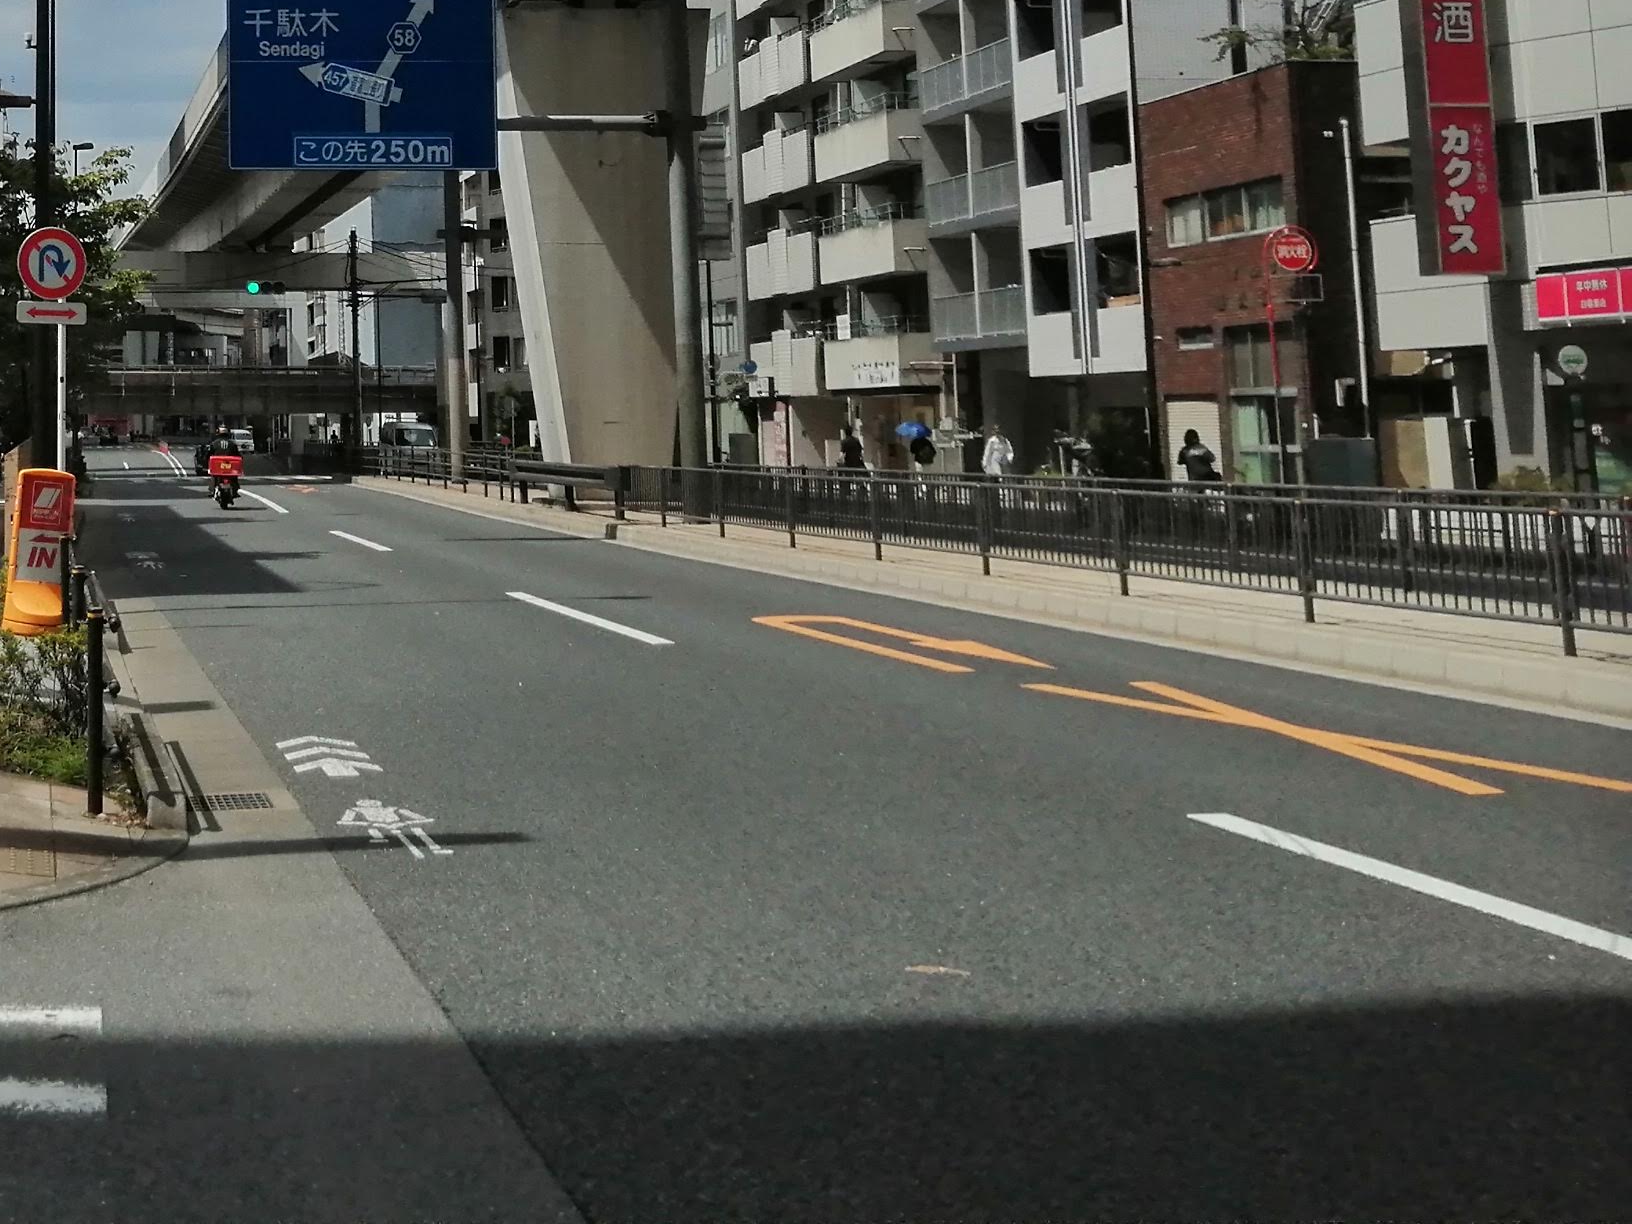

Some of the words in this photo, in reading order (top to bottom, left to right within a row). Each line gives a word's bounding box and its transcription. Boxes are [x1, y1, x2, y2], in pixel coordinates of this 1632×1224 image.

[243, 8, 340, 38] 千駄木
[1431, 1, 1474, 45] 酒
[393, 29, 416, 47] 58
[259, 41, 326, 59] Sendagi
[324, 70, 348, 87] 457
[1440, 123, 1479, 255] カクヤス
[26, 546, 59, 569] IN
